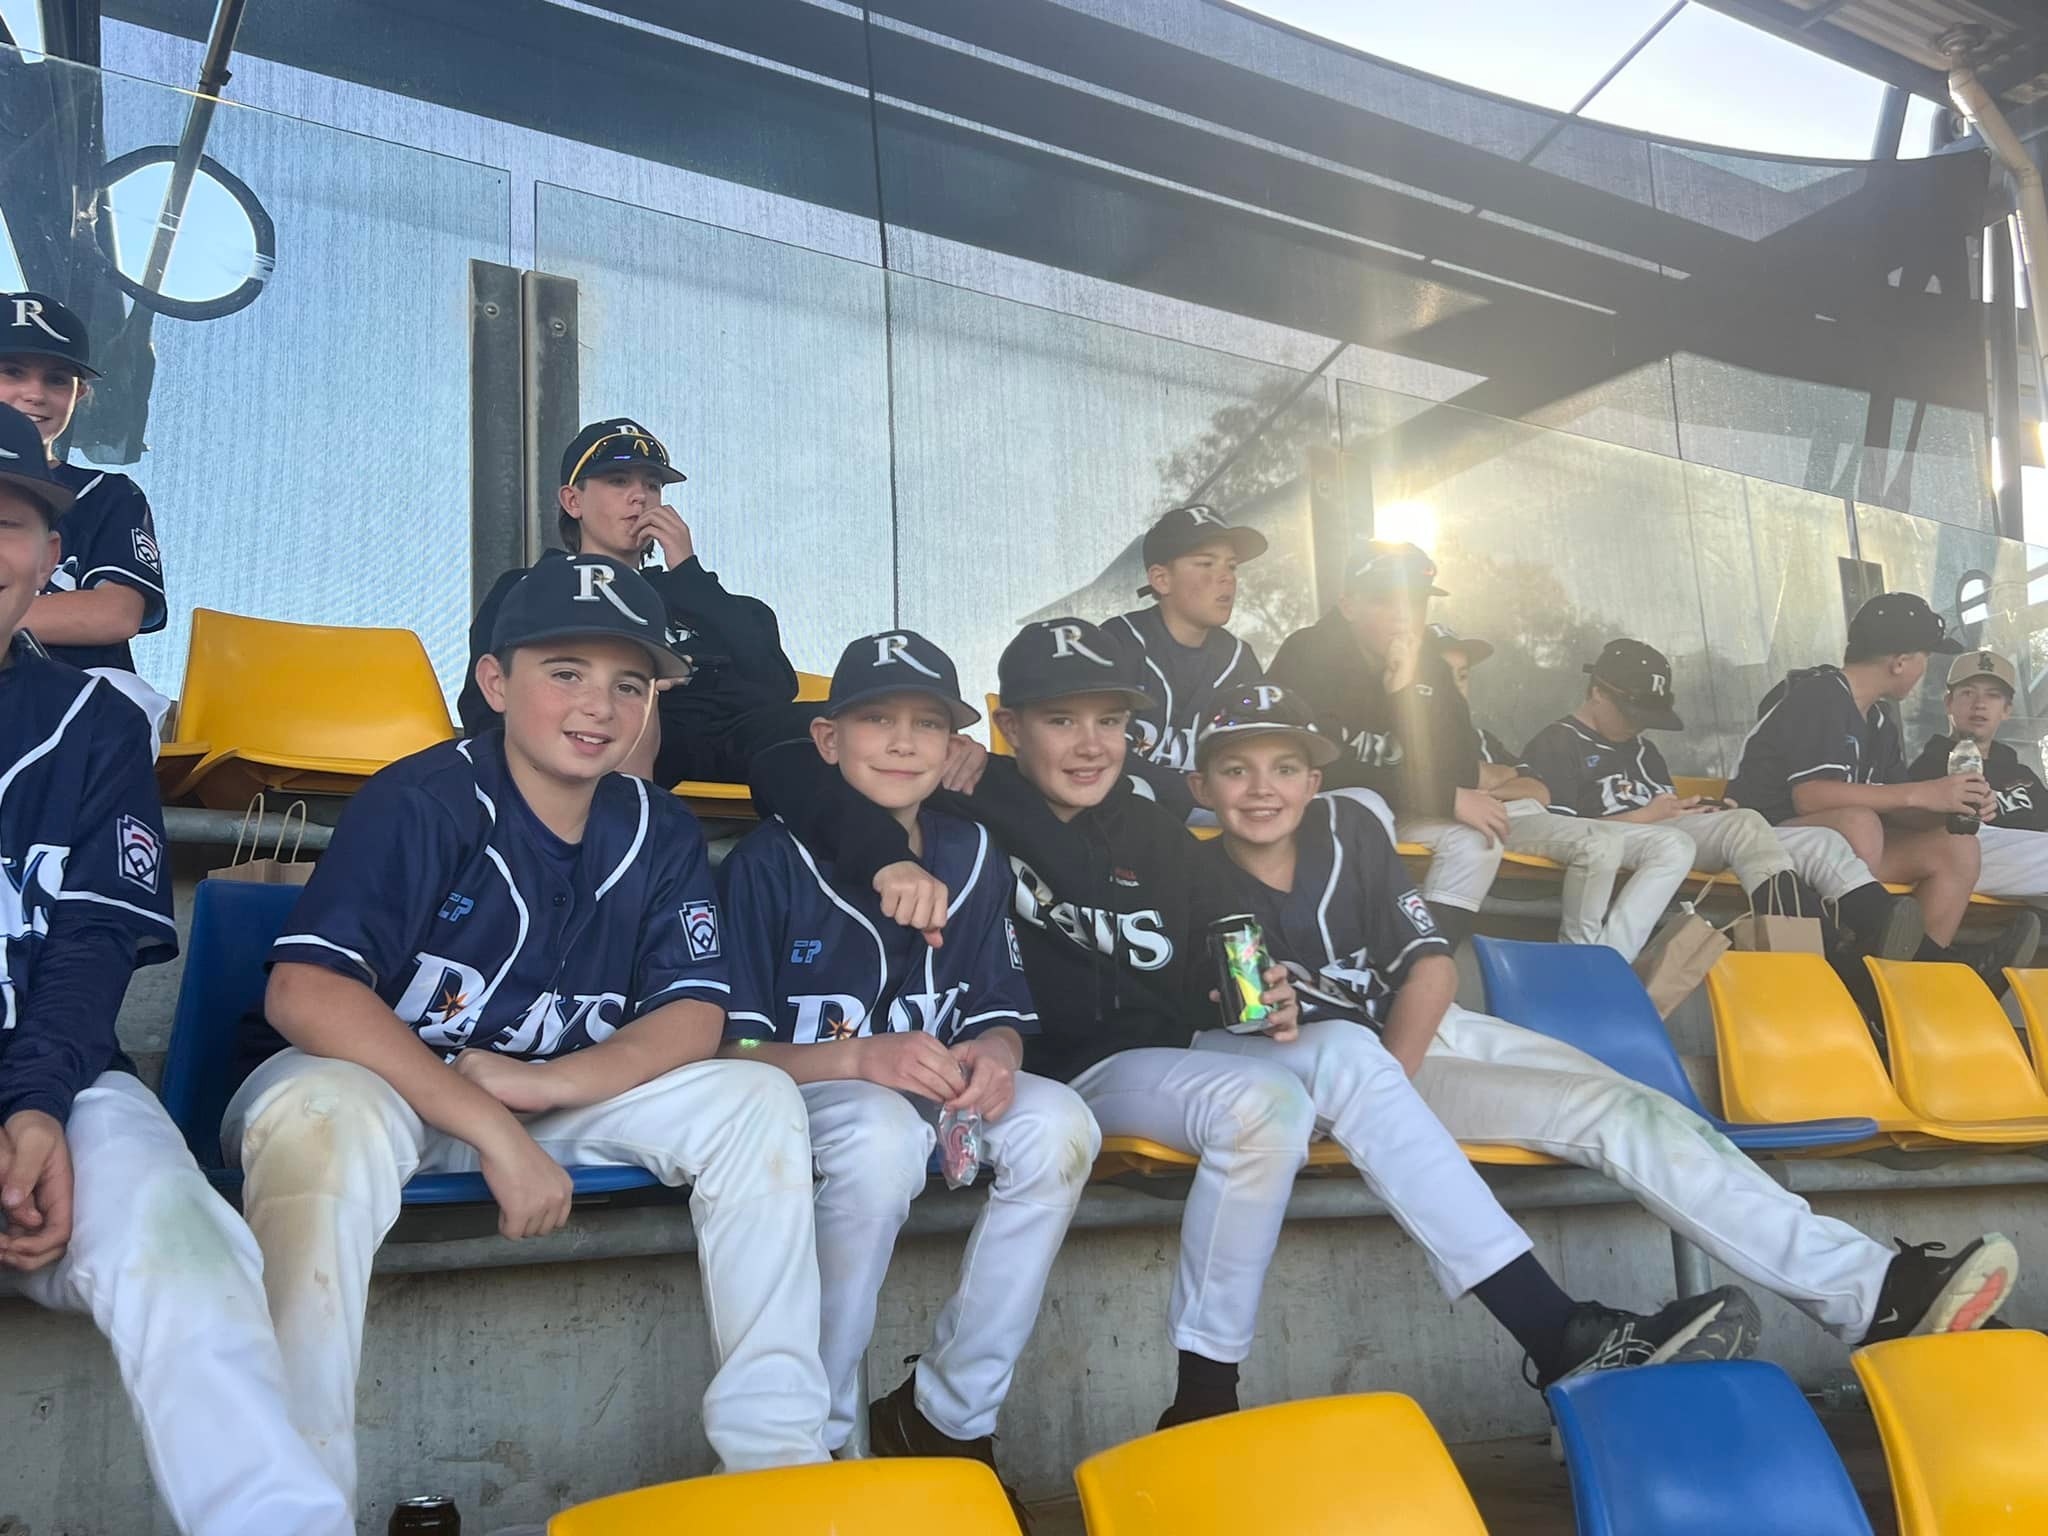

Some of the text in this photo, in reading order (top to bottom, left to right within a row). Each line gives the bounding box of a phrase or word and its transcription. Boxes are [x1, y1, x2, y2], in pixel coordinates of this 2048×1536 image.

[11, 299, 71, 343] R
[1185, 506, 1232, 529] R
[573, 564, 648, 625] R
[873, 635, 941, 679] R
[1050, 625, 1114, 667] R
[1651, 673, 1666, 696] R
